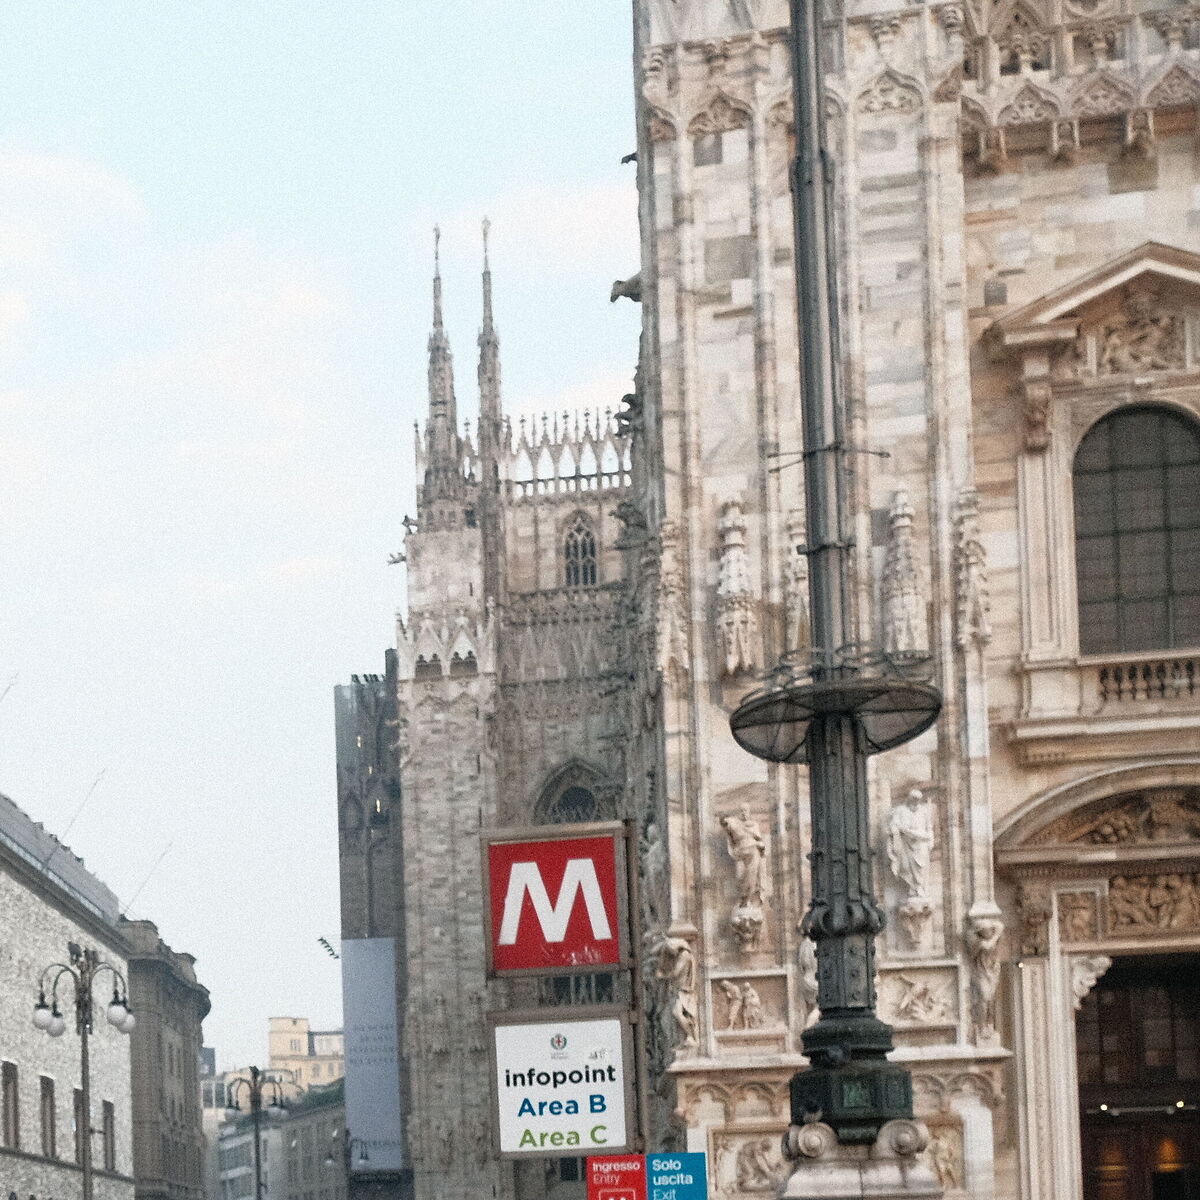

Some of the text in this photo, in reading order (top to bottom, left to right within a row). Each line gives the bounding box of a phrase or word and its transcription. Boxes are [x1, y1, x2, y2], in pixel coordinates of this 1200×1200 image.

[498, 858, 612, 945] M
[505, 1065, 616, 1088] infopoint
[518, 1094, 607, 1117] Area B
[519, 1125, 608, 1148] Area C
[592, 1162, 641, 1173] Ingresso
[652, 1159, 682, 1171] Solo
[593, 1174, 620, 1185] Entry
[653, 1173, 693, 1186] uscita
[653, 1189, 677, 1200] Exit
